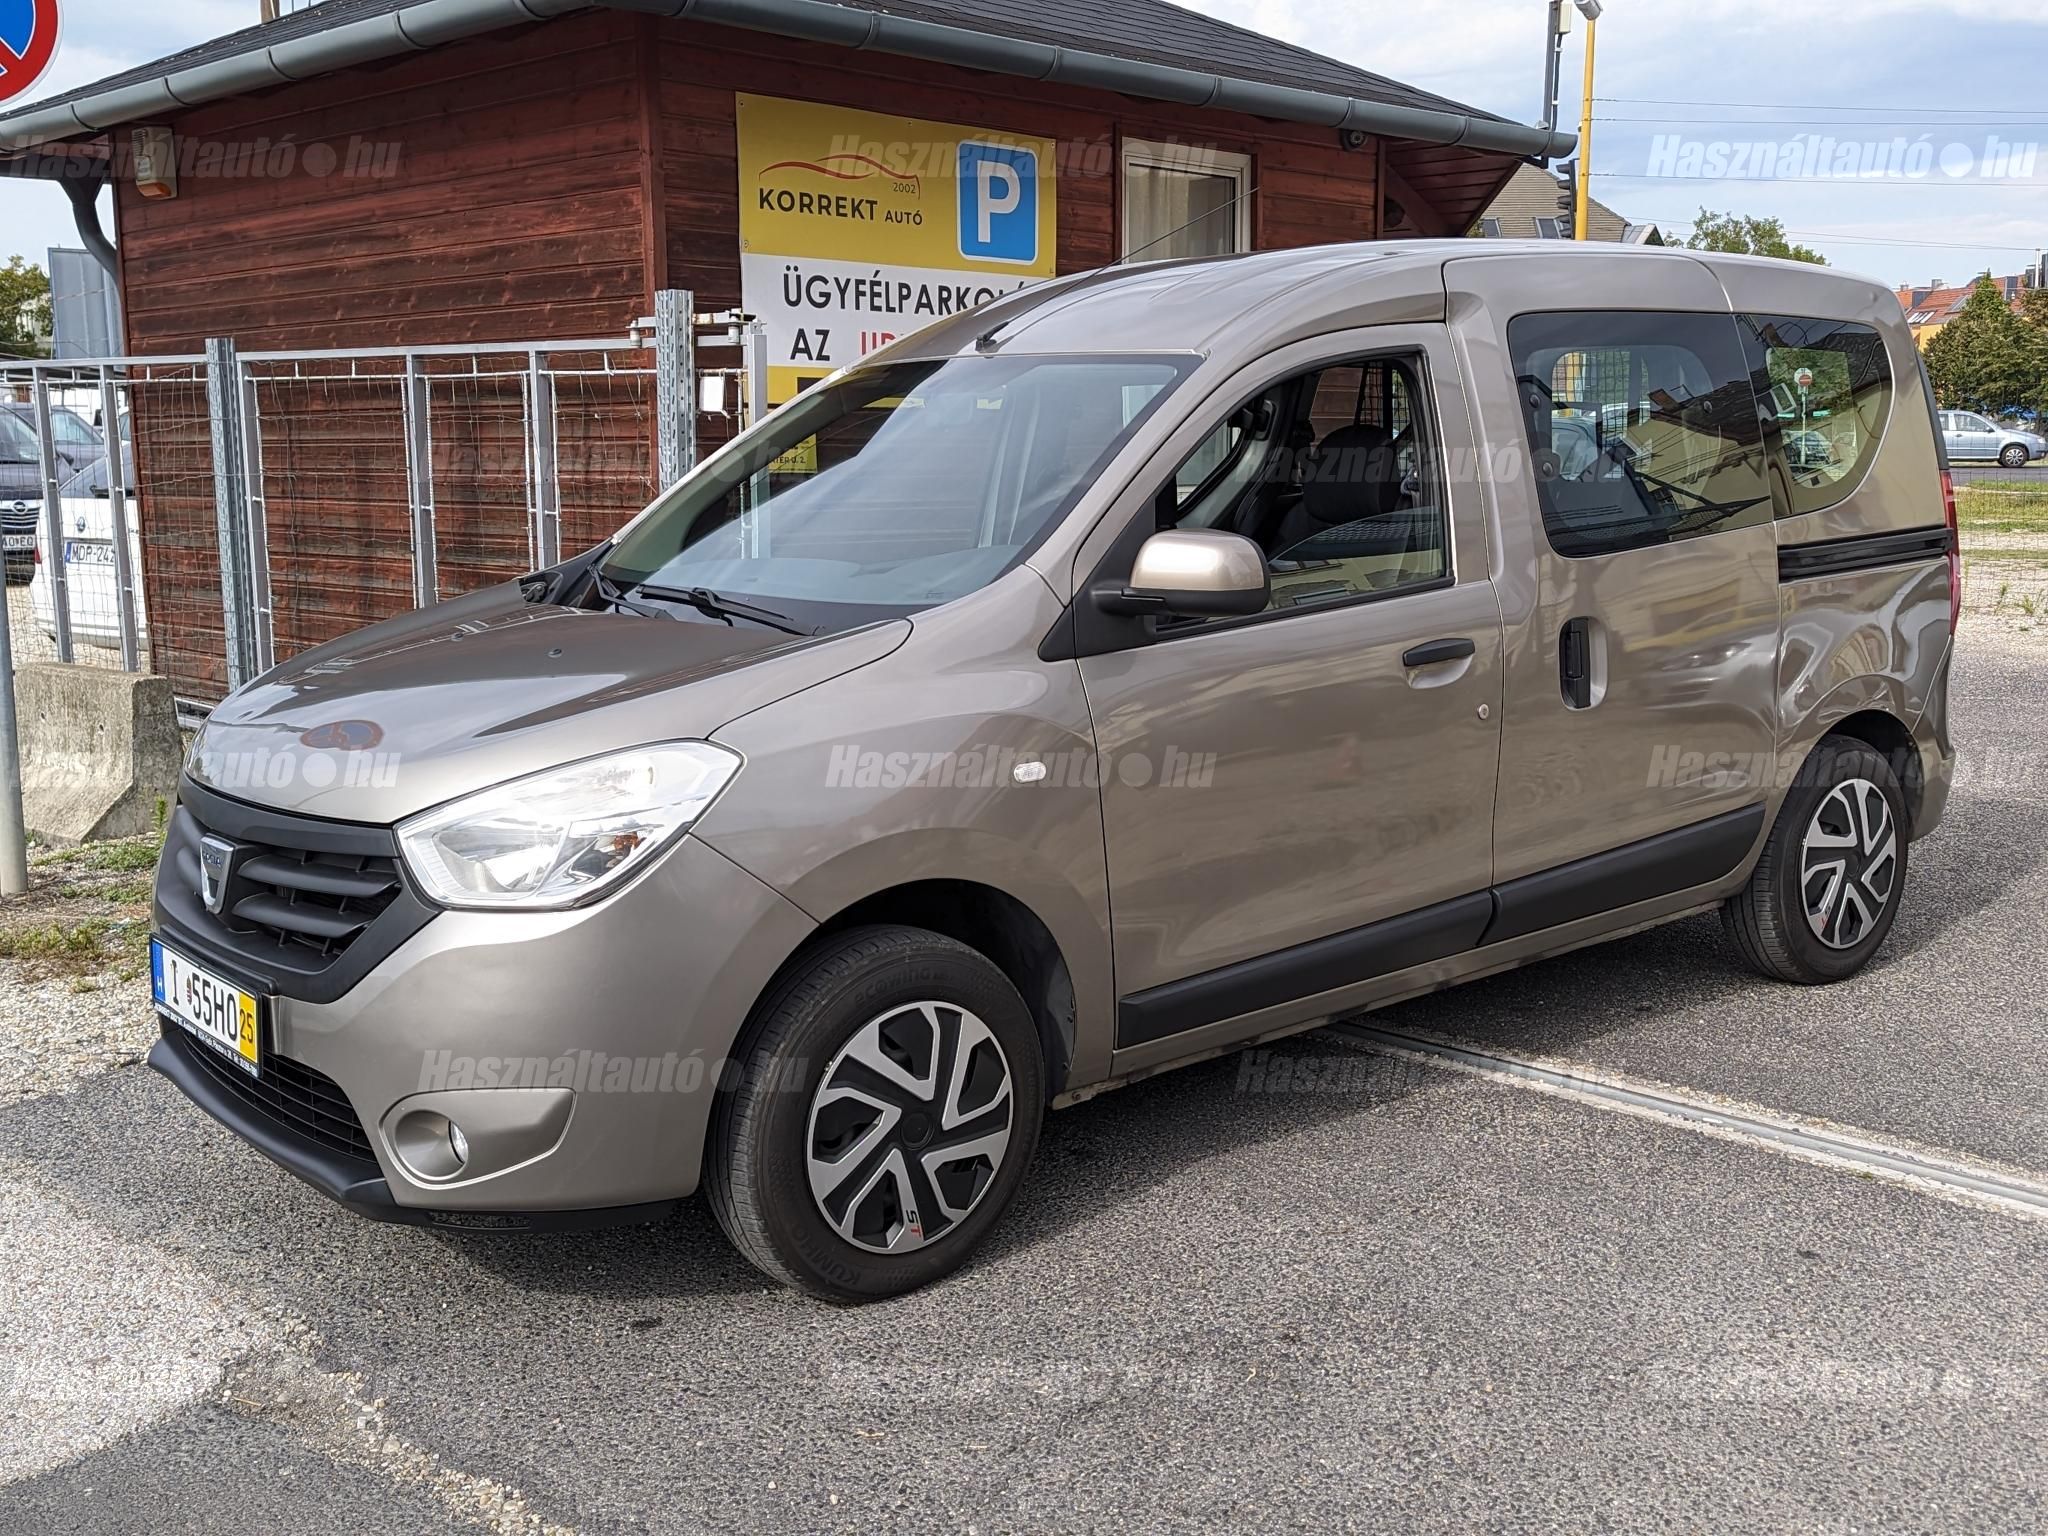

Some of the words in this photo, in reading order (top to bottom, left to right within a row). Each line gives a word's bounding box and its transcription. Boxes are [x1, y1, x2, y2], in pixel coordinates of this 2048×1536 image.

[892, 182, 916, 195] 2002
[759, 187, 878, 221] KORREKT
[884, 208, 923, 226] AUTÓ
[790, 328, 831, 361] AZ
[239, 1008, 254, 1044] 25
